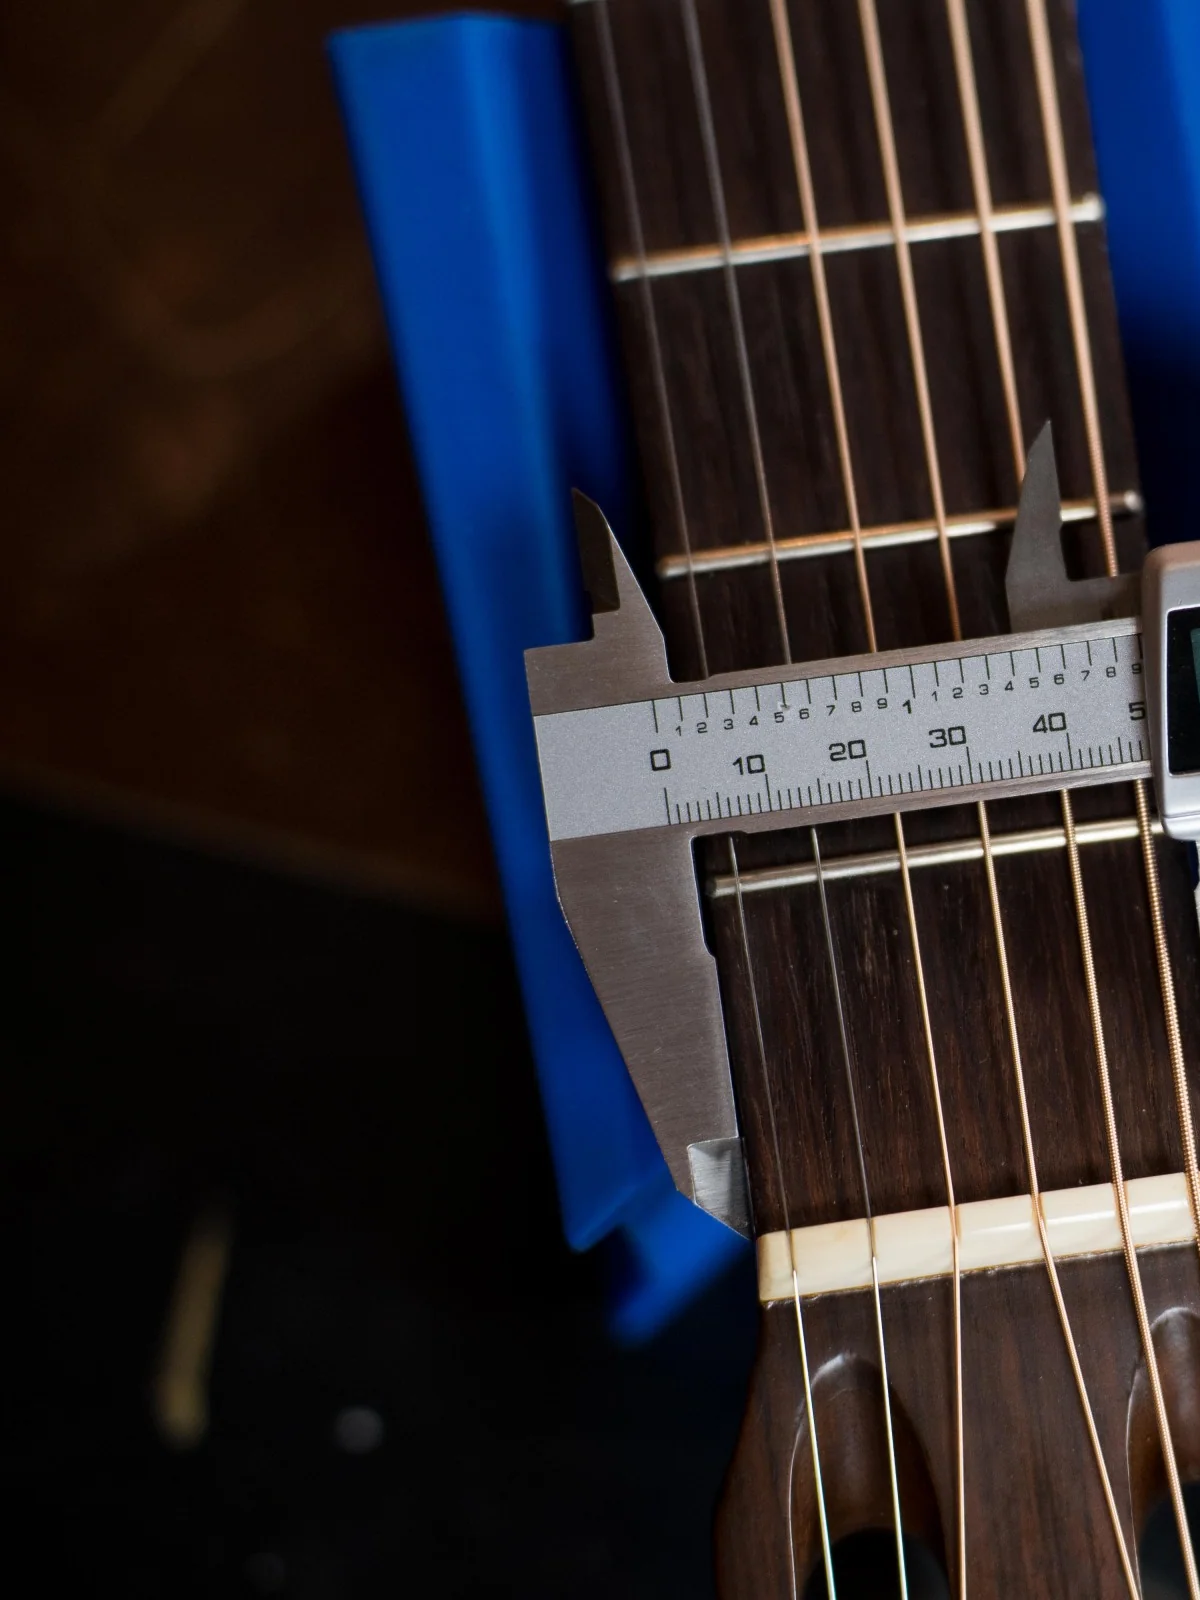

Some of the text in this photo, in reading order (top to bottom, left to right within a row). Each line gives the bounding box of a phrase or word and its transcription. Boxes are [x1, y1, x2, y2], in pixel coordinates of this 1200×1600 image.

[675, 662, 1143, 737] 1 2 3 4 5 6 7 8 9 1 1 2 3 4 5 6 7 8 9
[649, 748, 672, 772] 0
[732, 753, 767, 776] 10
[828, 739, 867, 763] 20
[928, 725, 968, 749] 30
[1032, 711, 1067, 734] 40
